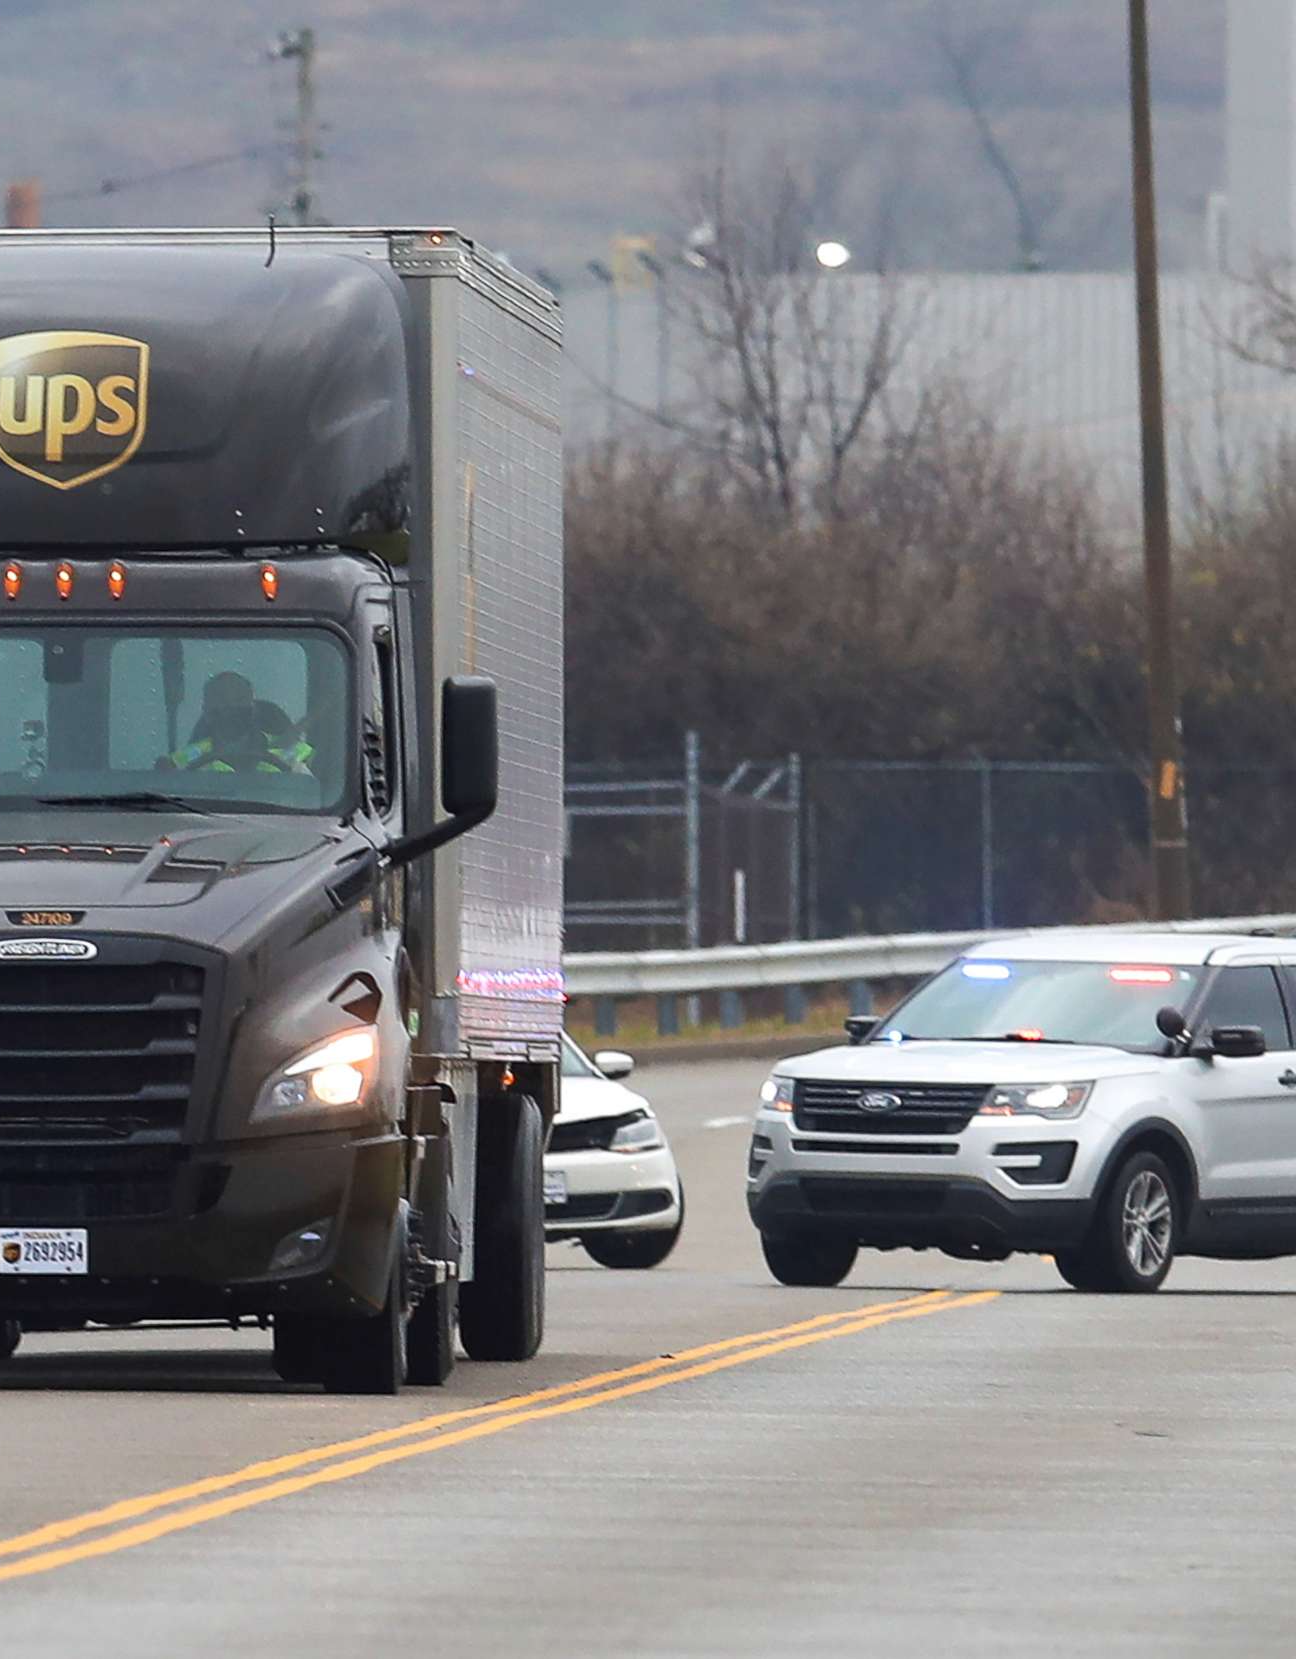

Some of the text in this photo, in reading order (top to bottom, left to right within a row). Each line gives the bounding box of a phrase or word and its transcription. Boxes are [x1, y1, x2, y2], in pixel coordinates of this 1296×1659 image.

[21, 911, 73, 925] 247109
[23, 1231, 62, 1240] INDIANA
[23, 1241, 84, 1262] 2692954
